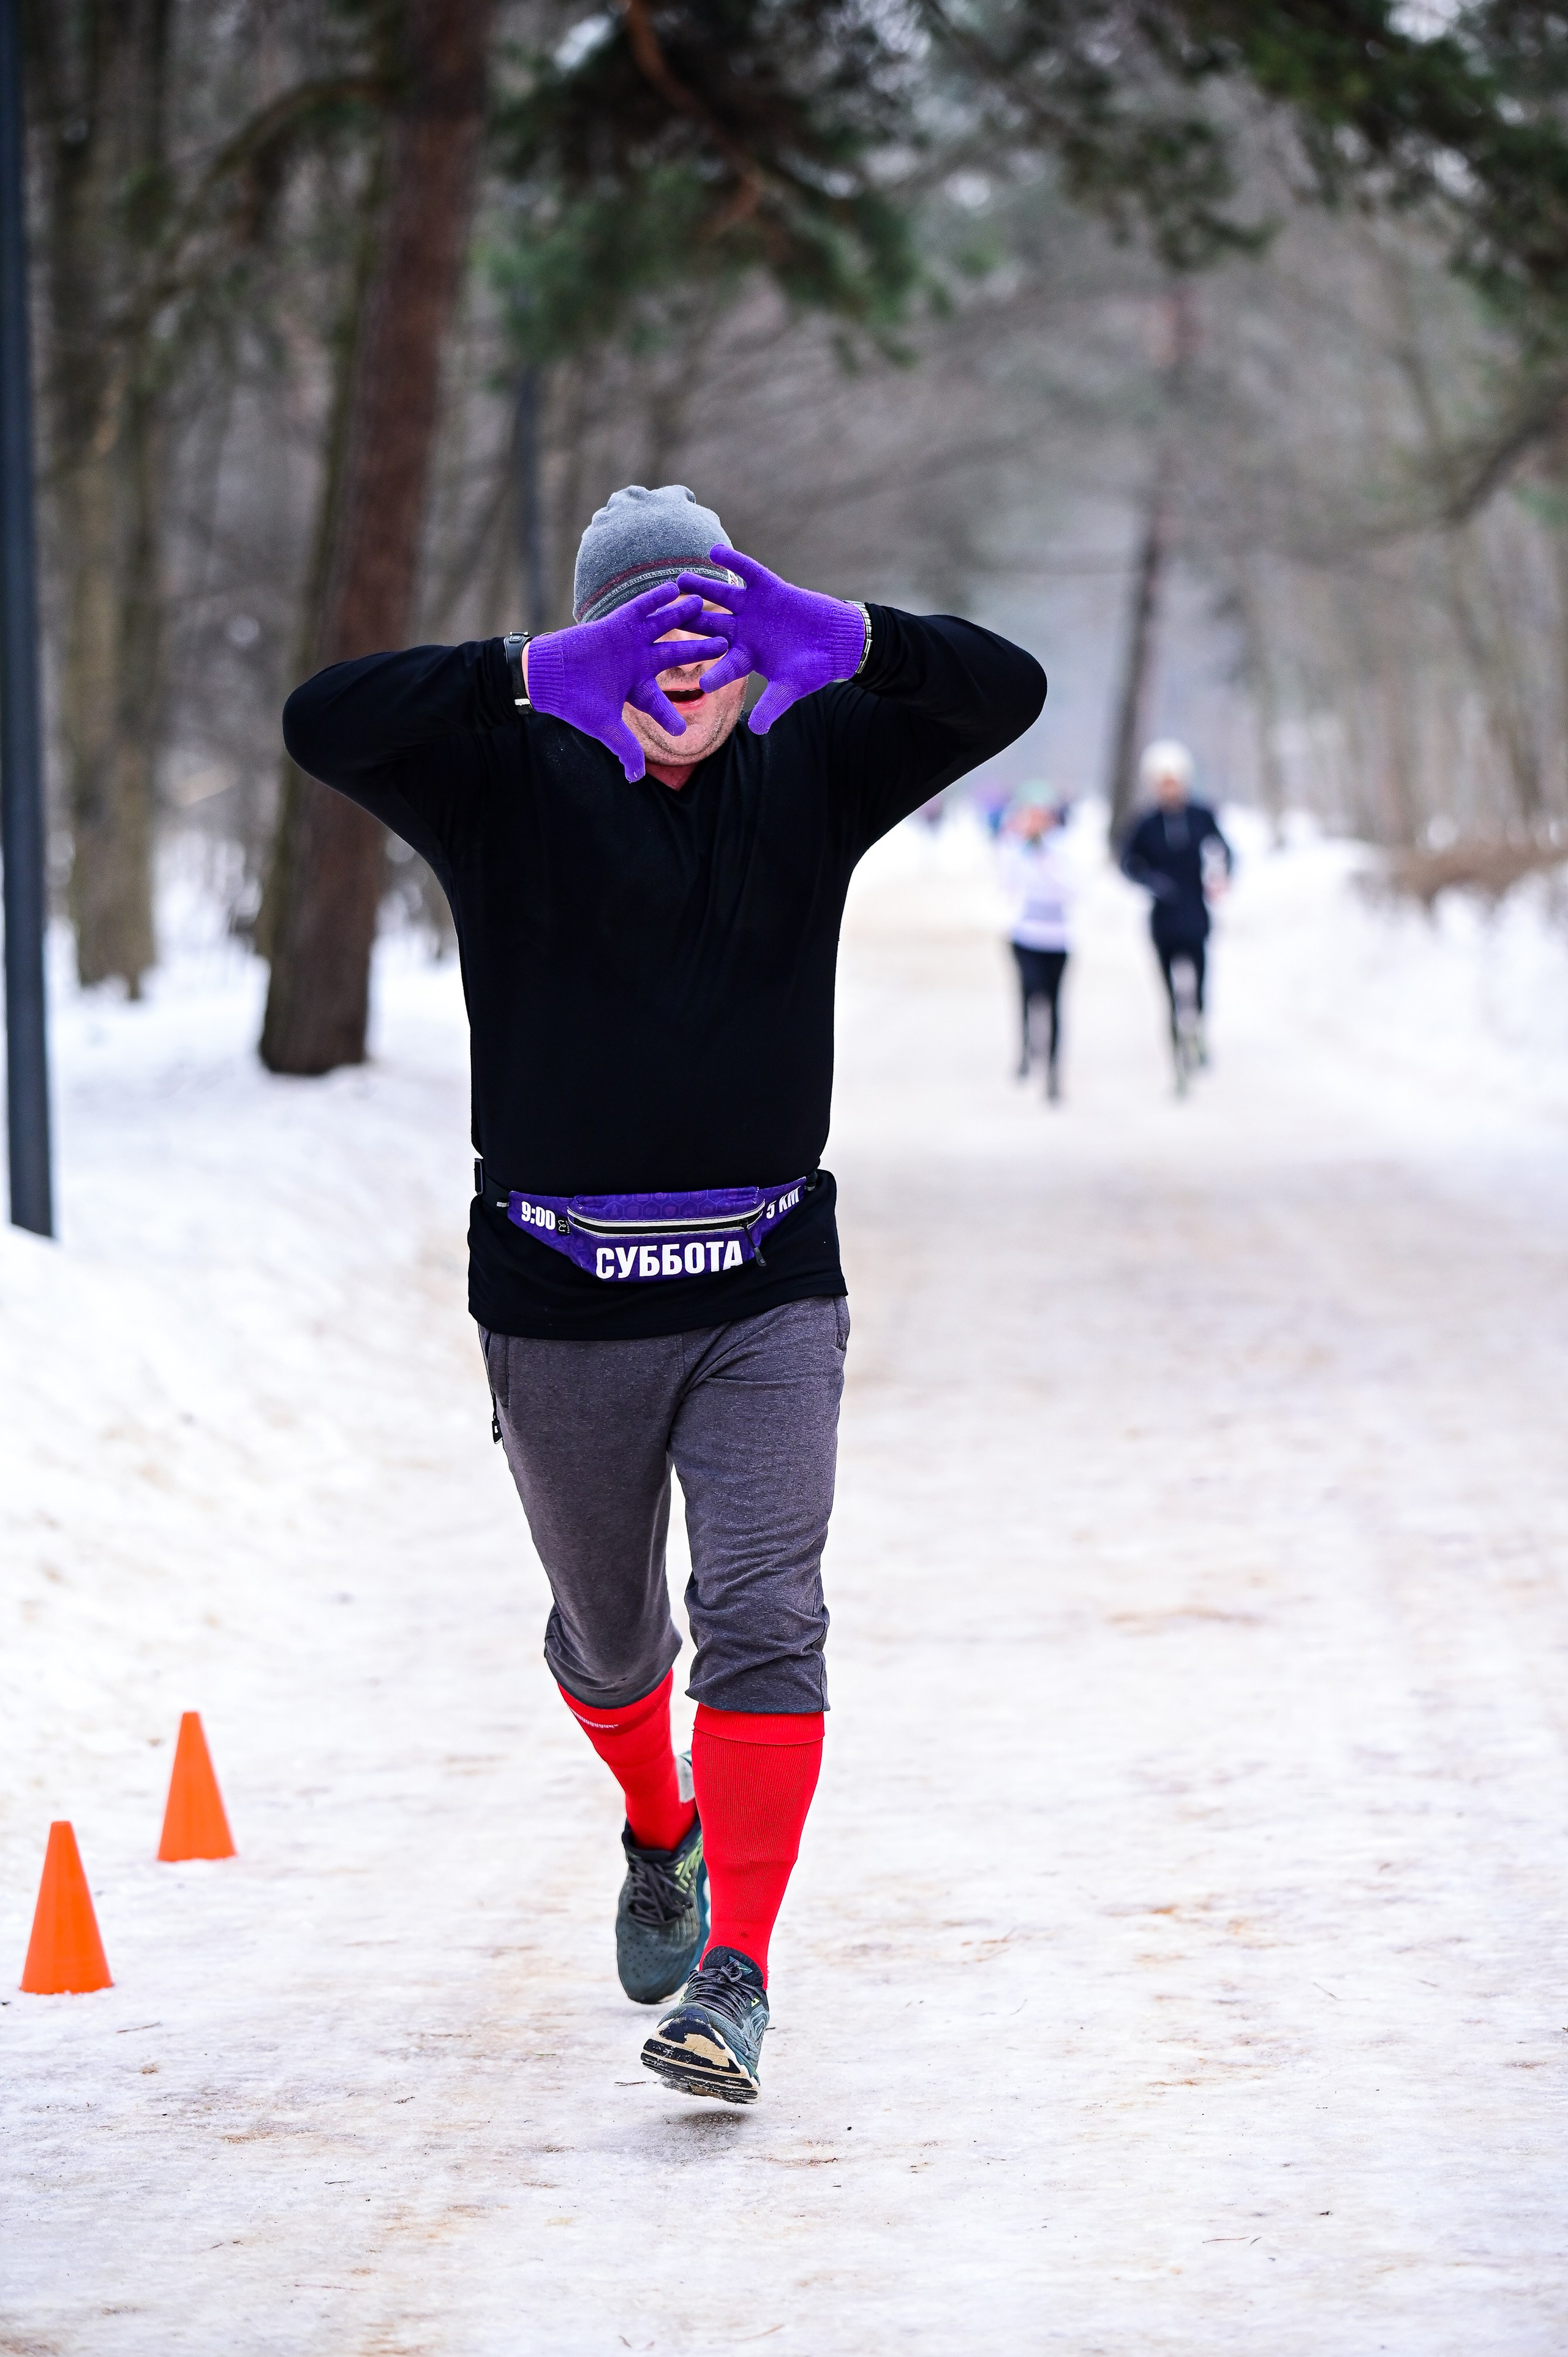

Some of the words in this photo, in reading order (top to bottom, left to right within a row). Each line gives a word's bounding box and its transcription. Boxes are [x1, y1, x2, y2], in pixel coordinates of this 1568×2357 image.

[521, 1201, 556, 1230] 9:00
[766, 1200, 777, 1219] 5
[596, 1240, 744, 1279] СУББОТА
